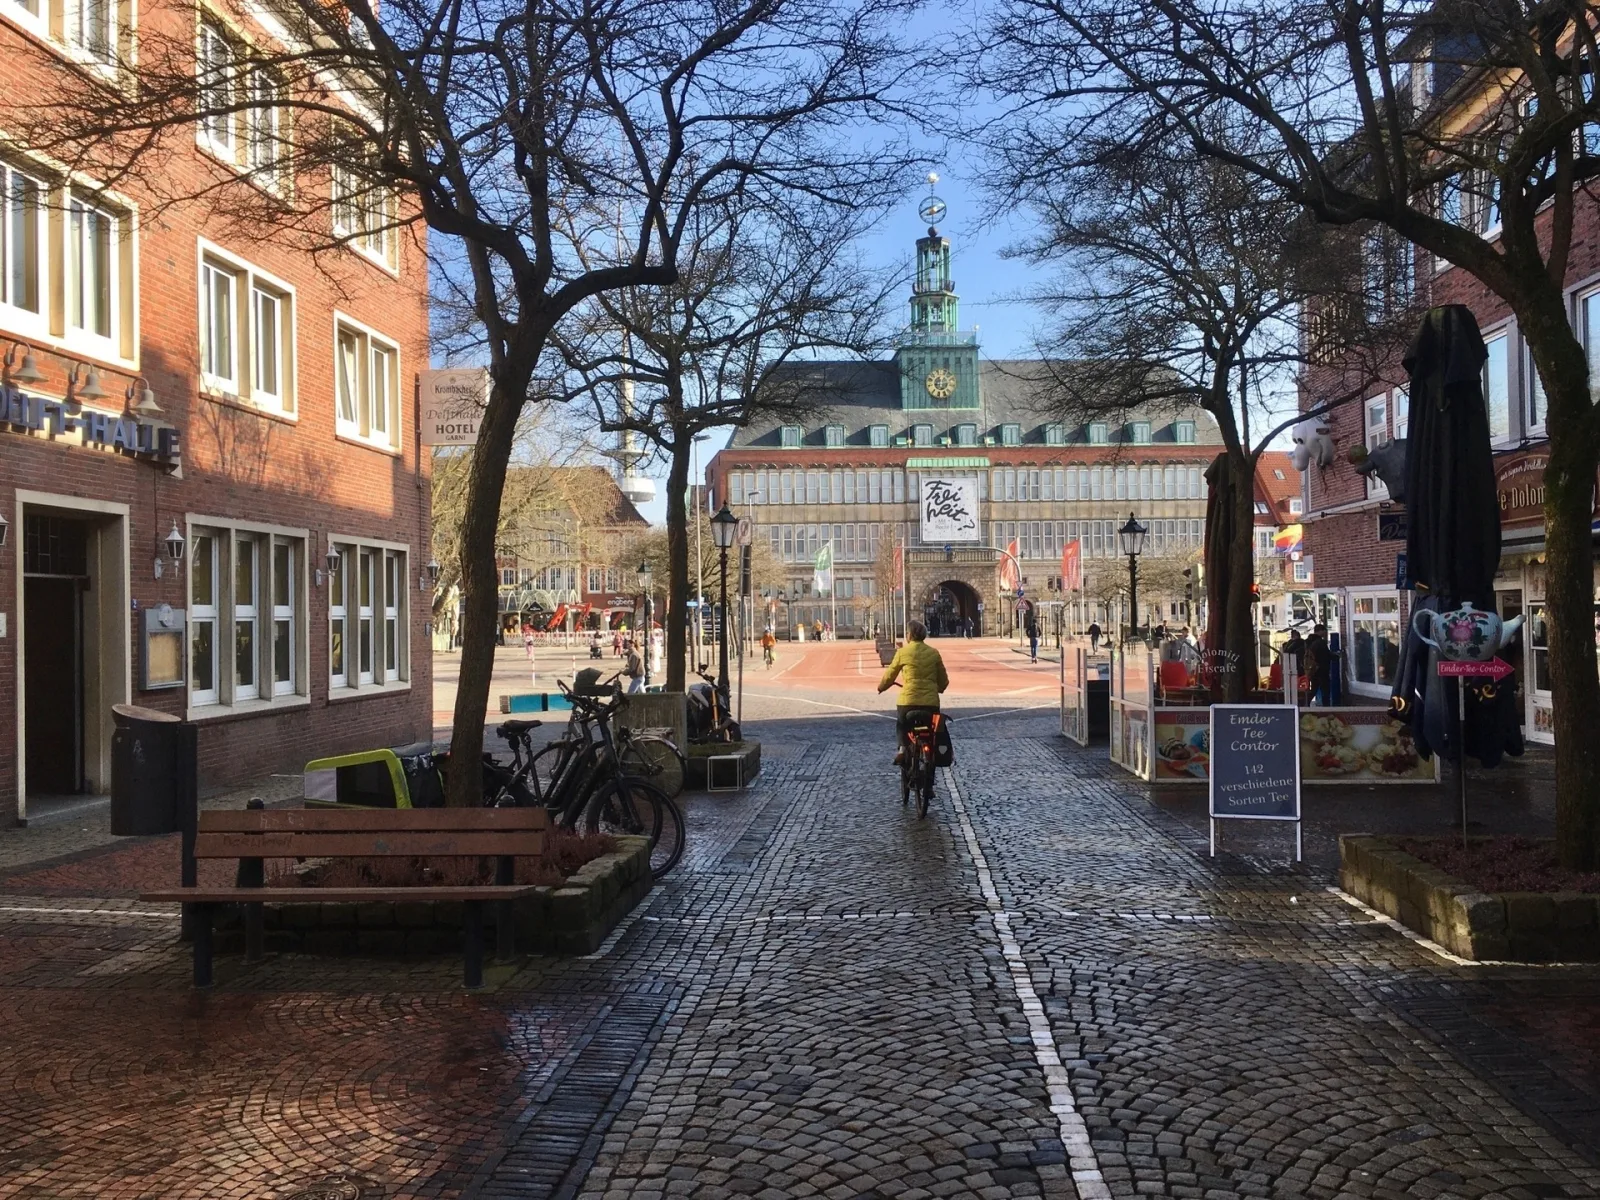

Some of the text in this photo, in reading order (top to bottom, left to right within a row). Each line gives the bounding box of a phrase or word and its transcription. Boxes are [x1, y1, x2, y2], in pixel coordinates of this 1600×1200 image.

[435, 424, 476, 434] HOTEL
[925, 480, 962, 506] Frei
[1440, 664, 1506, 673] Emder-Tee-Contor
[1230, 713, 1280, 725] Emder-
[1242, 728, 1267, 739] Tee
[1230, 740, 1280, 751] Contor
[1244, 764, 1264, 775] 142
[1220, 778, 1293, 792] verschiedene
[1228, 791, 1289, 807] Sorten Tee
